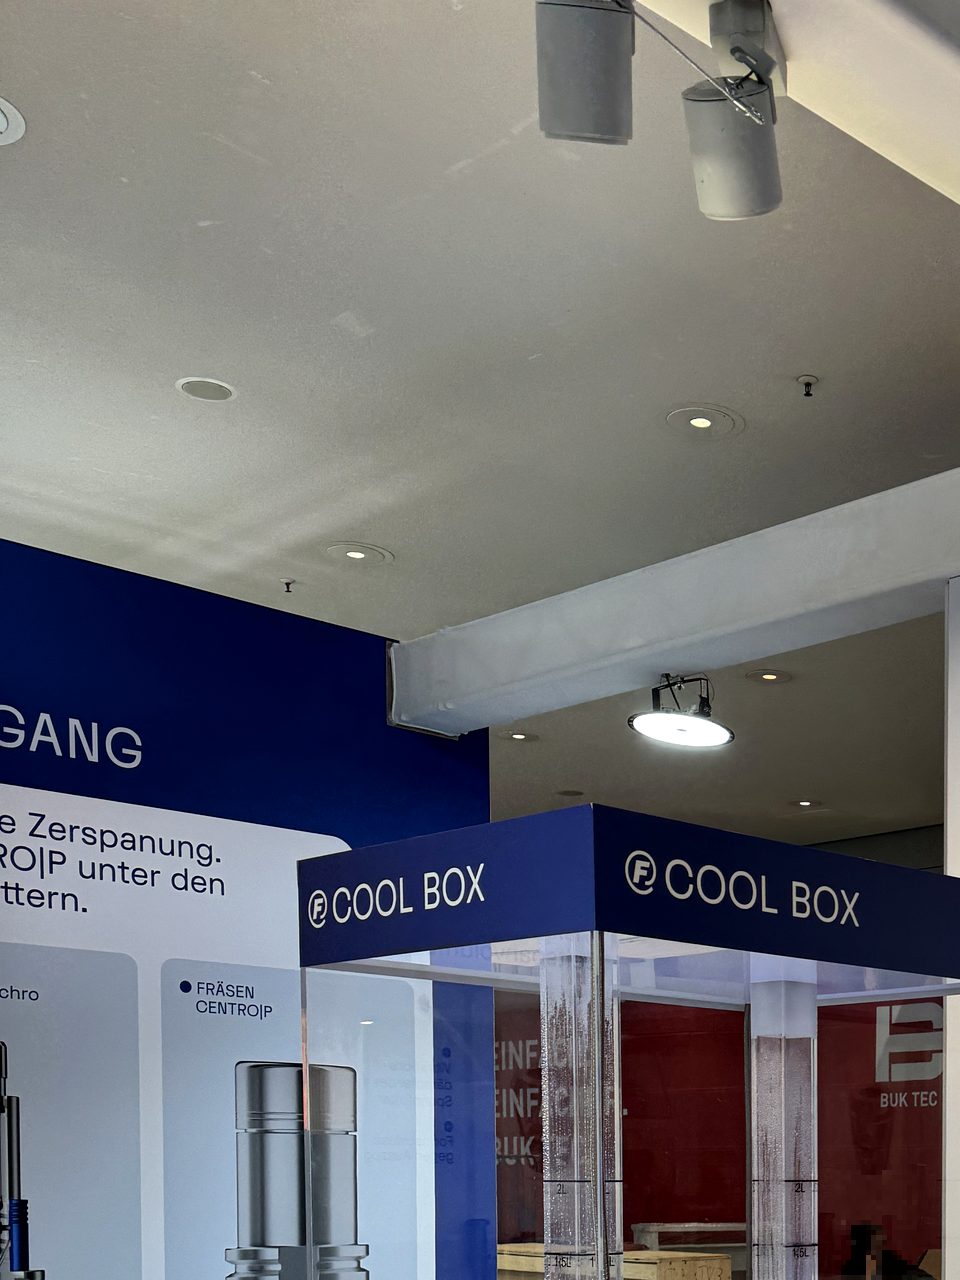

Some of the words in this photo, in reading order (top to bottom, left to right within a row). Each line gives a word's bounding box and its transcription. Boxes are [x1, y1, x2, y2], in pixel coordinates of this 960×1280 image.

[0, 704, 142, 769] GANG
[28, 812, 221, 867] Zerspanung.
[78, 860, 161, 887] unter
[171, 868, 225, 896] den
[332, 877, 414, 924] COOL
[423, 863, 485, 910] BOX
[665, 859, 778, 914] COOL
[792, 881, 860, 927] BOX
[0, 985, 39, 1001] chro
[197, 981, 254, 999] FRÄSEN
[880, 1092, 909, 1108] BUK
[912, 1090, 938, 1107] TEC
